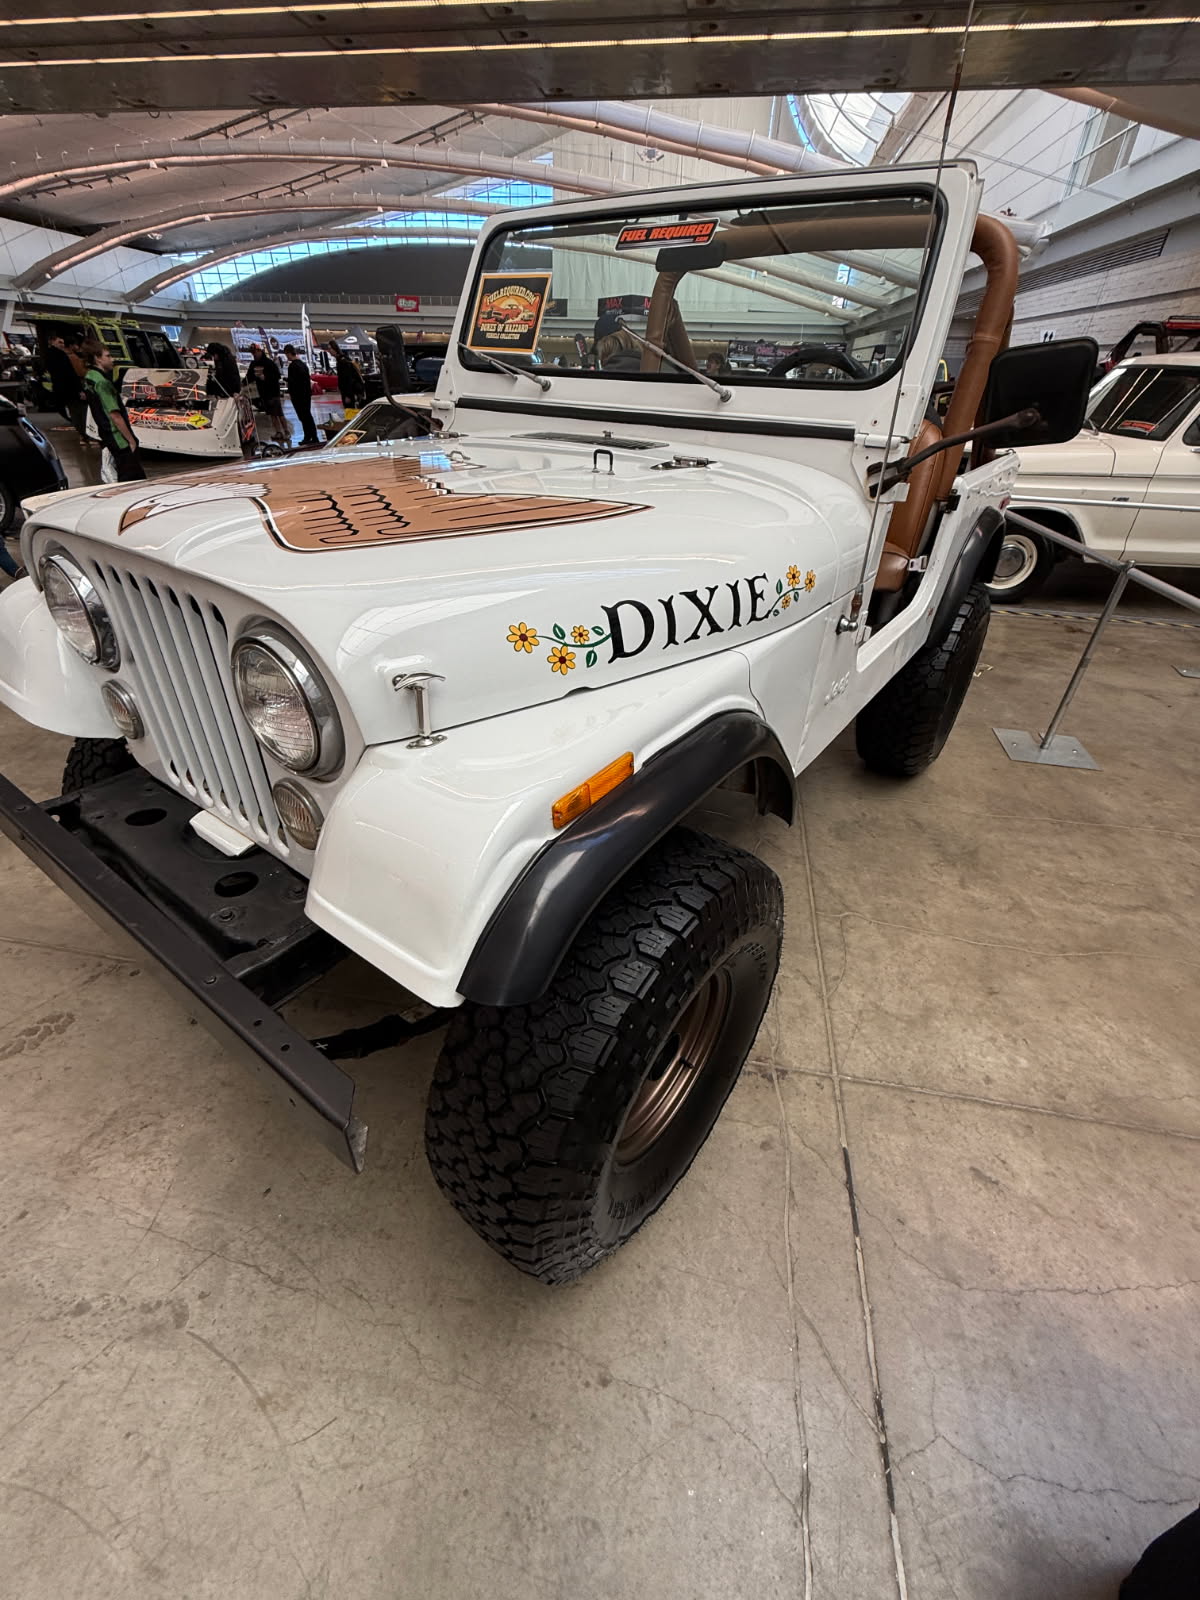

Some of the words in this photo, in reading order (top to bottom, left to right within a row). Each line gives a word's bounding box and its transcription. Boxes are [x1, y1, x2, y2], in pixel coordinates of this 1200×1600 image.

[620, 229, 648, 242] FUEL
[649, 223, 714, 239] REQUIRED
[605, 298, 623, 309] MAX
[480, 323, 497, 332] DUKES
[497, 324, 505, 332] OF
[504, 324, 529, 333] HAZZARD
[601, 572, 773, 664] DIXIE
